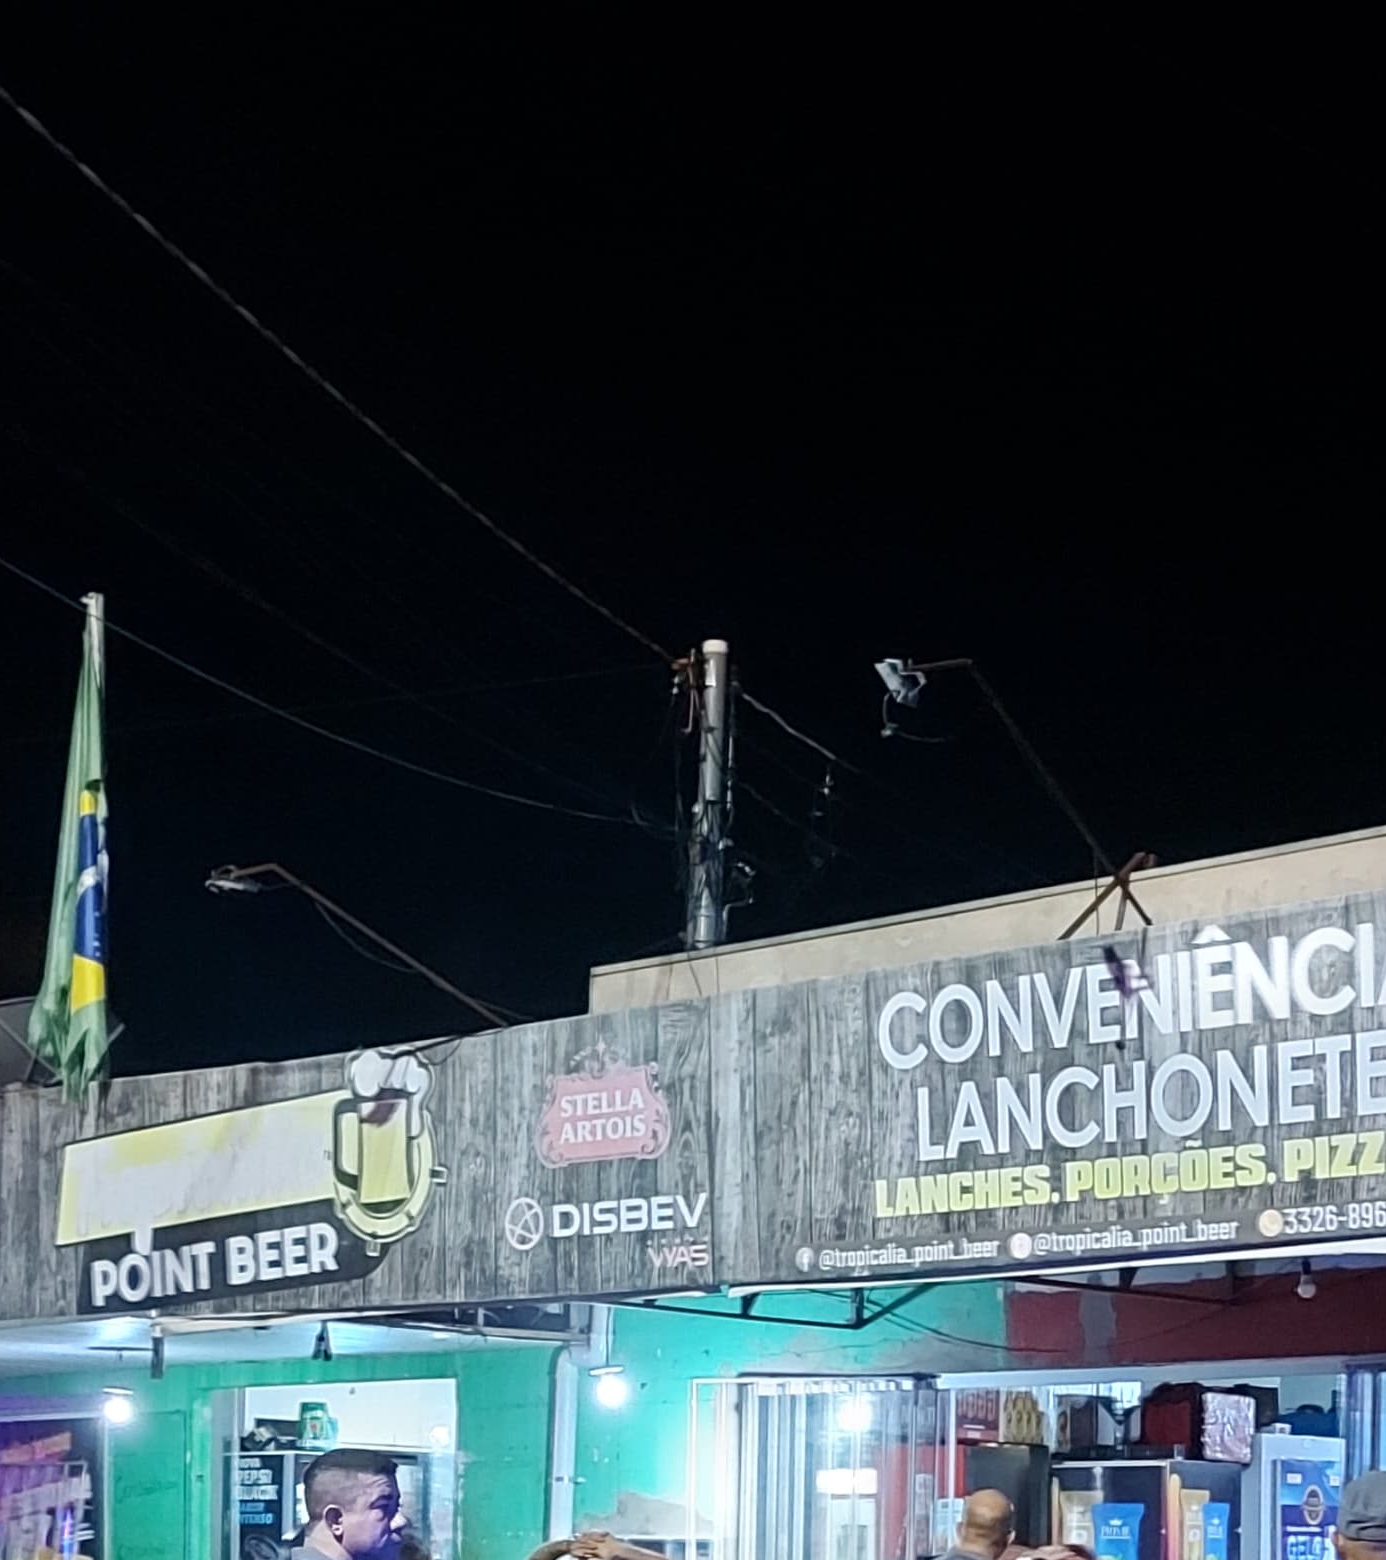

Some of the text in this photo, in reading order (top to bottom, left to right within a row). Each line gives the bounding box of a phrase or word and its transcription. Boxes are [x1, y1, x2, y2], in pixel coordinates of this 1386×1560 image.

[561, 1088, 645, 1117] STELLA
[559, 1114, 647, 1145] ARTOIS
[551, 1192, 708, 1238] DISBEV
[90, 1221, 339, 1307] POINT BEER
